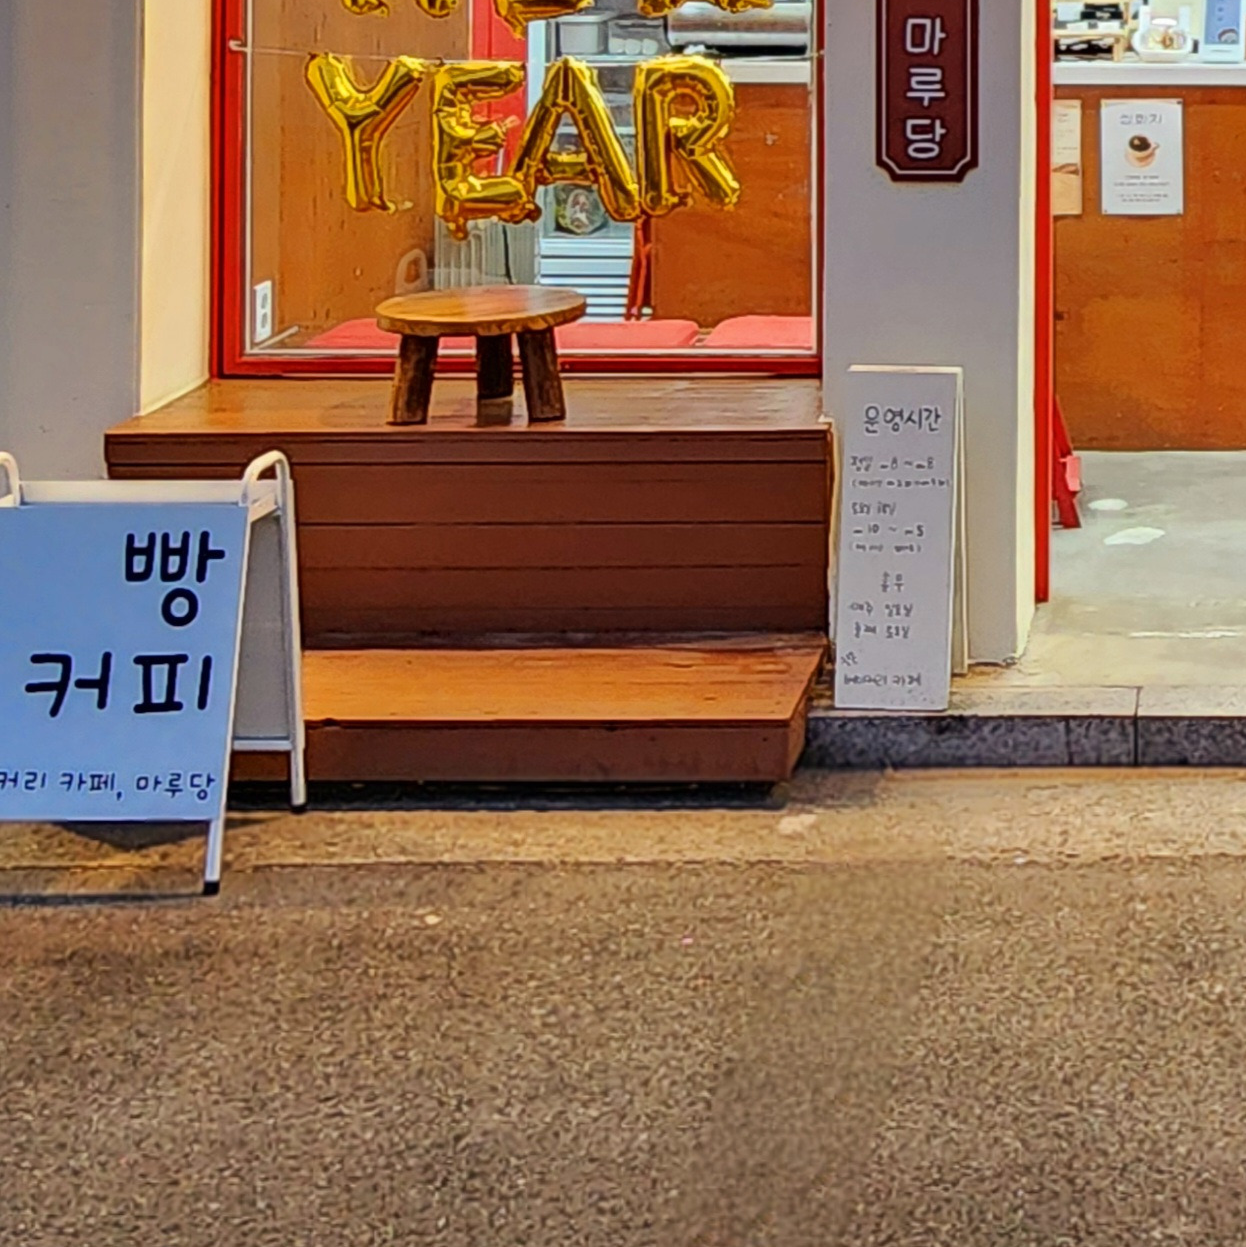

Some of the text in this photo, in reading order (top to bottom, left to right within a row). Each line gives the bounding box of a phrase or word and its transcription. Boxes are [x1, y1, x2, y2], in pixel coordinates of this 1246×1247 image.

[905, 17, 947, 159] 마루당
[304, 52, 742, 240] YEAR
[862, 405, 942, 435] 운영시간
[123, 530, 226, 627] 빵
[24, 651, 213, 718] 커피
[60, 772, 122, 801] 카페,
[135, 772, 216, 800] 마루당
